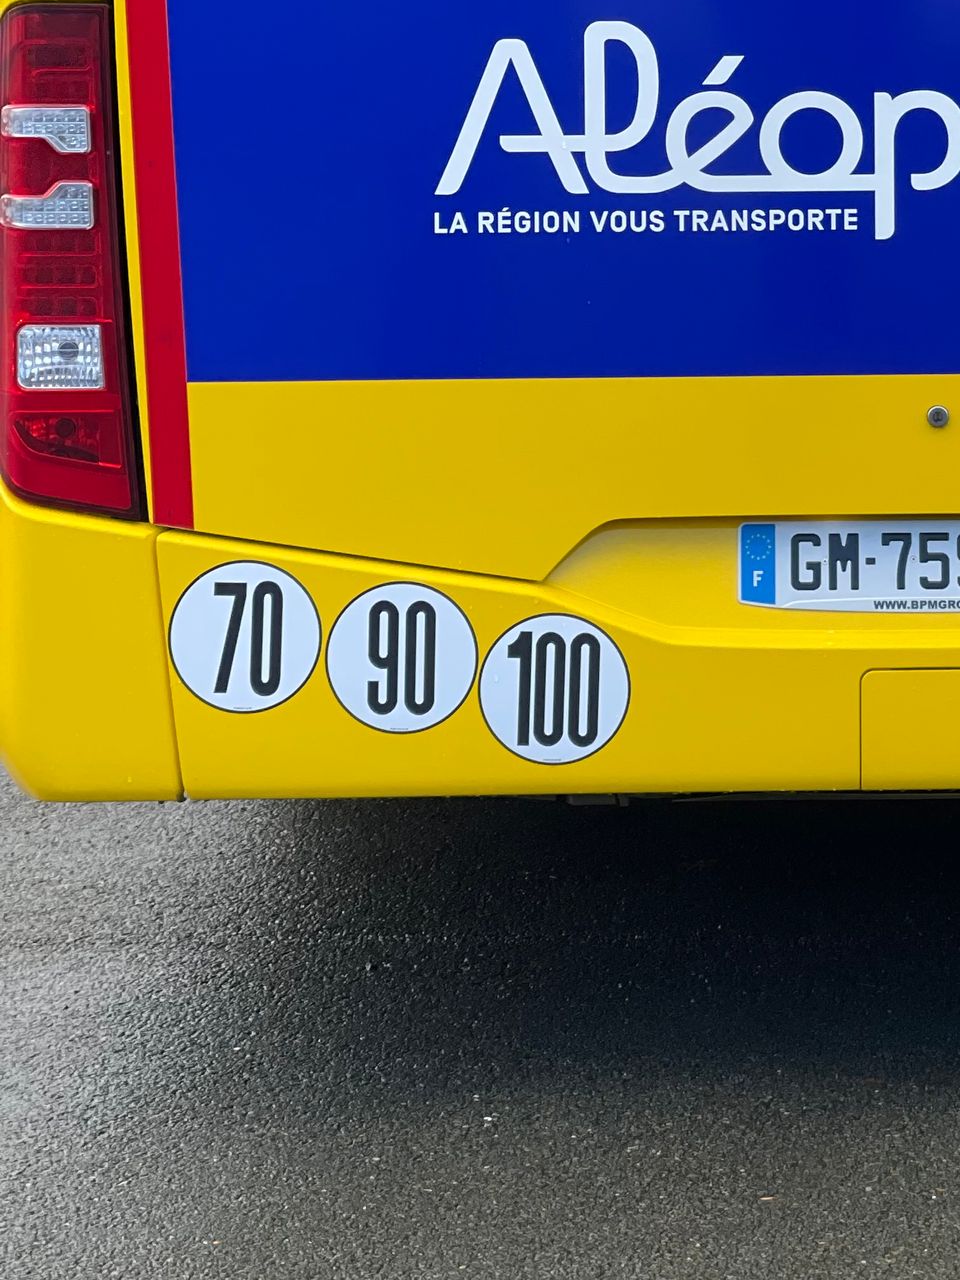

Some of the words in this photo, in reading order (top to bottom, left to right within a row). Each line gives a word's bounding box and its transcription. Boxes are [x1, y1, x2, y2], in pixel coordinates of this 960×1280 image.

[433, 212, 469, 235] LA
[477, 207, 581, 234] RÉGION
[589, 210, 665, 233] VOUS
[672, 208, 859, 232] TRANSPORTE
[752, 570, 765, 588] F
[213, 580, 284, 697] 70
[366, 599, 437, 716] 90
[507, 630, 600, 748] 100
